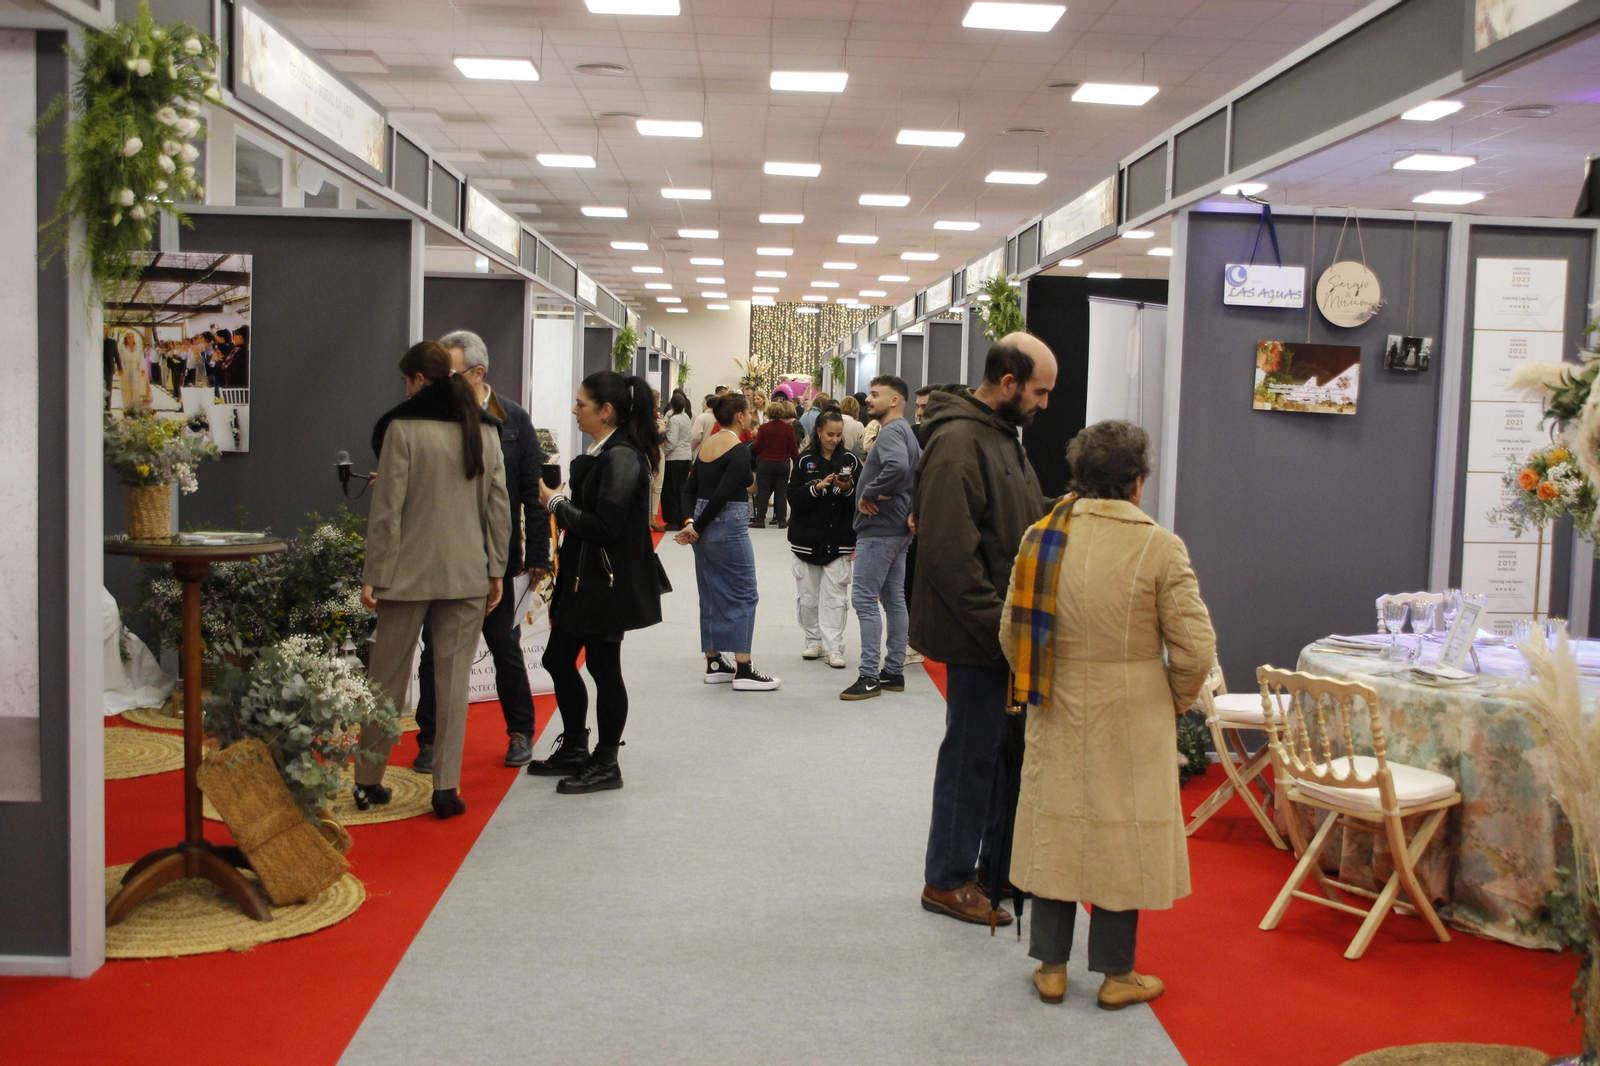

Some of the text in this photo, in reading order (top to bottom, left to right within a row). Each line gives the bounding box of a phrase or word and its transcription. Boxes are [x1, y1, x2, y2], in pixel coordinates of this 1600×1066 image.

[1228, 287, 1302, 304] LAS AGUAS
[1327, 275, 1369, 298] Sergio
[1323, 292, 1372, 310] Miriam
